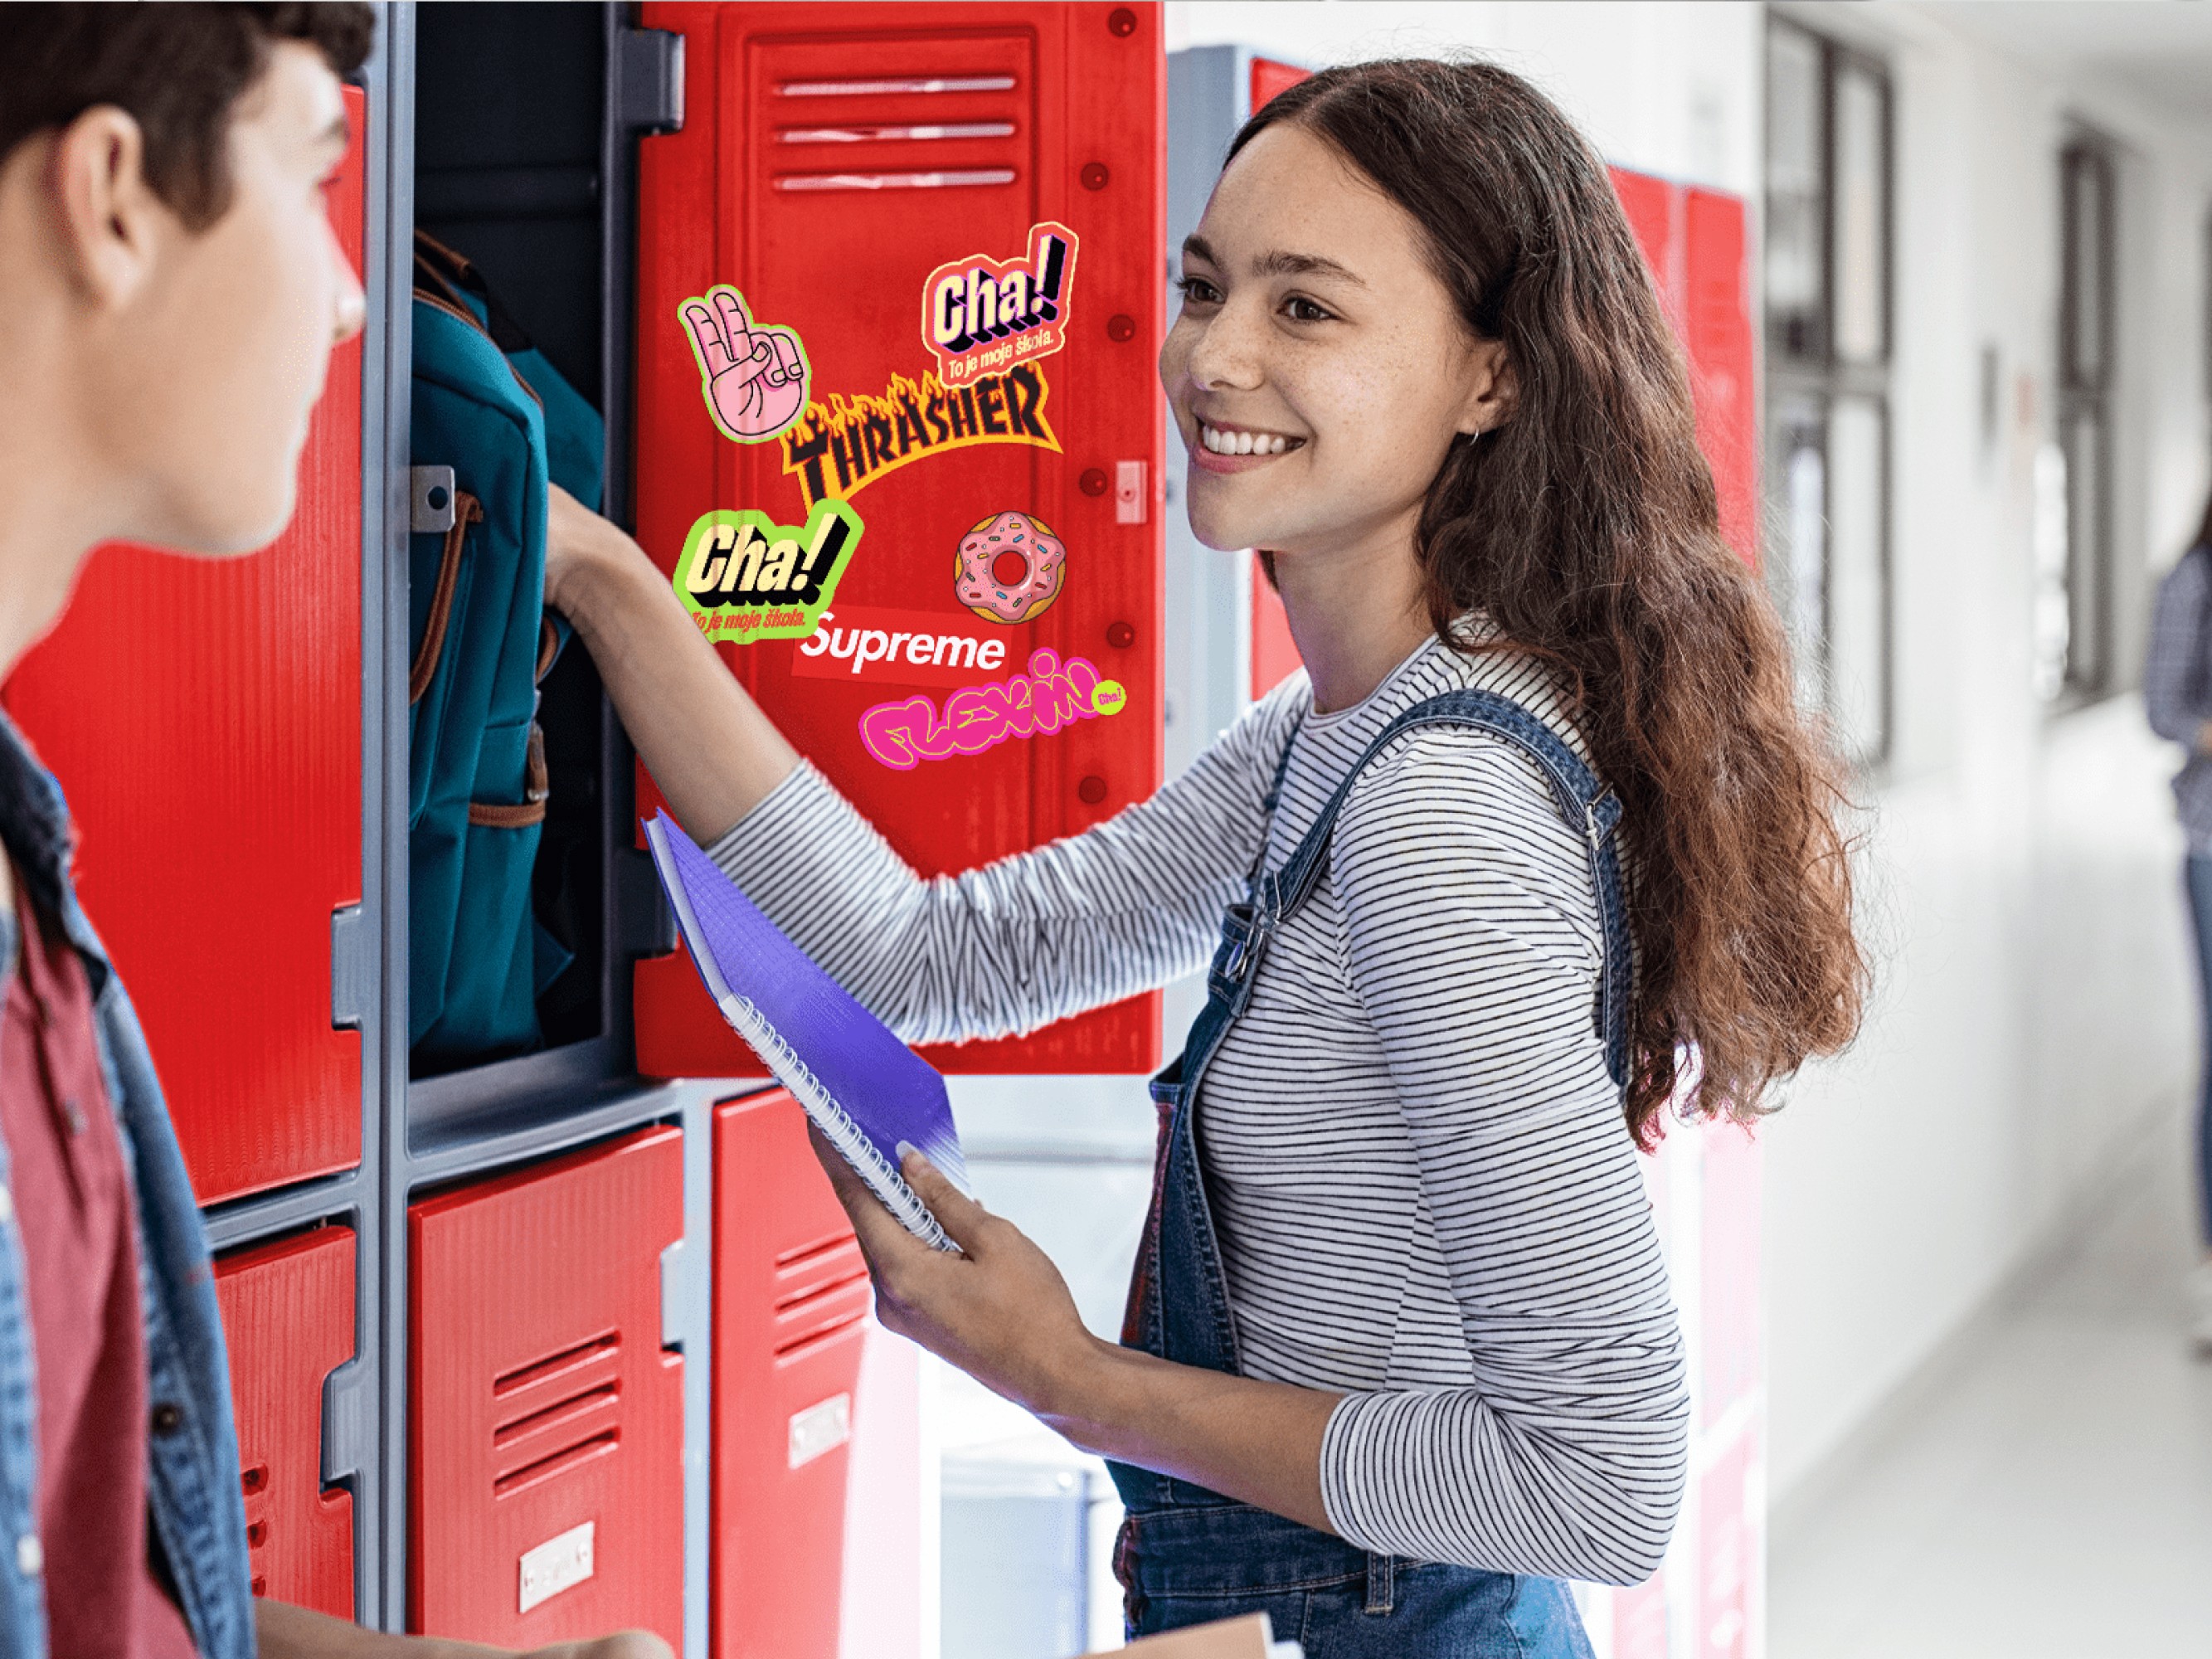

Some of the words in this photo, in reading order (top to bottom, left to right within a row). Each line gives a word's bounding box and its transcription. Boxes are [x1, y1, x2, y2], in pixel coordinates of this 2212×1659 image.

[934, 234, 1067, 353] Cha!
[948, 358, 964, 379] To
[964, 354, 978, 378] je
[980, 341, 1013, 367] moje
[1016, 329, 1054, 355] škola.
[786, 362, 1055, 508] THRASHER
[685, 513, 851, 607] Cha!
[704, 611, 723, 634] je
[723, 610, 762, 633] moje
[762, 608, 806, 629] škola.
[800, 611, 1005, 674] Supreme
[1097, 686, 1122, 707] Cha!
